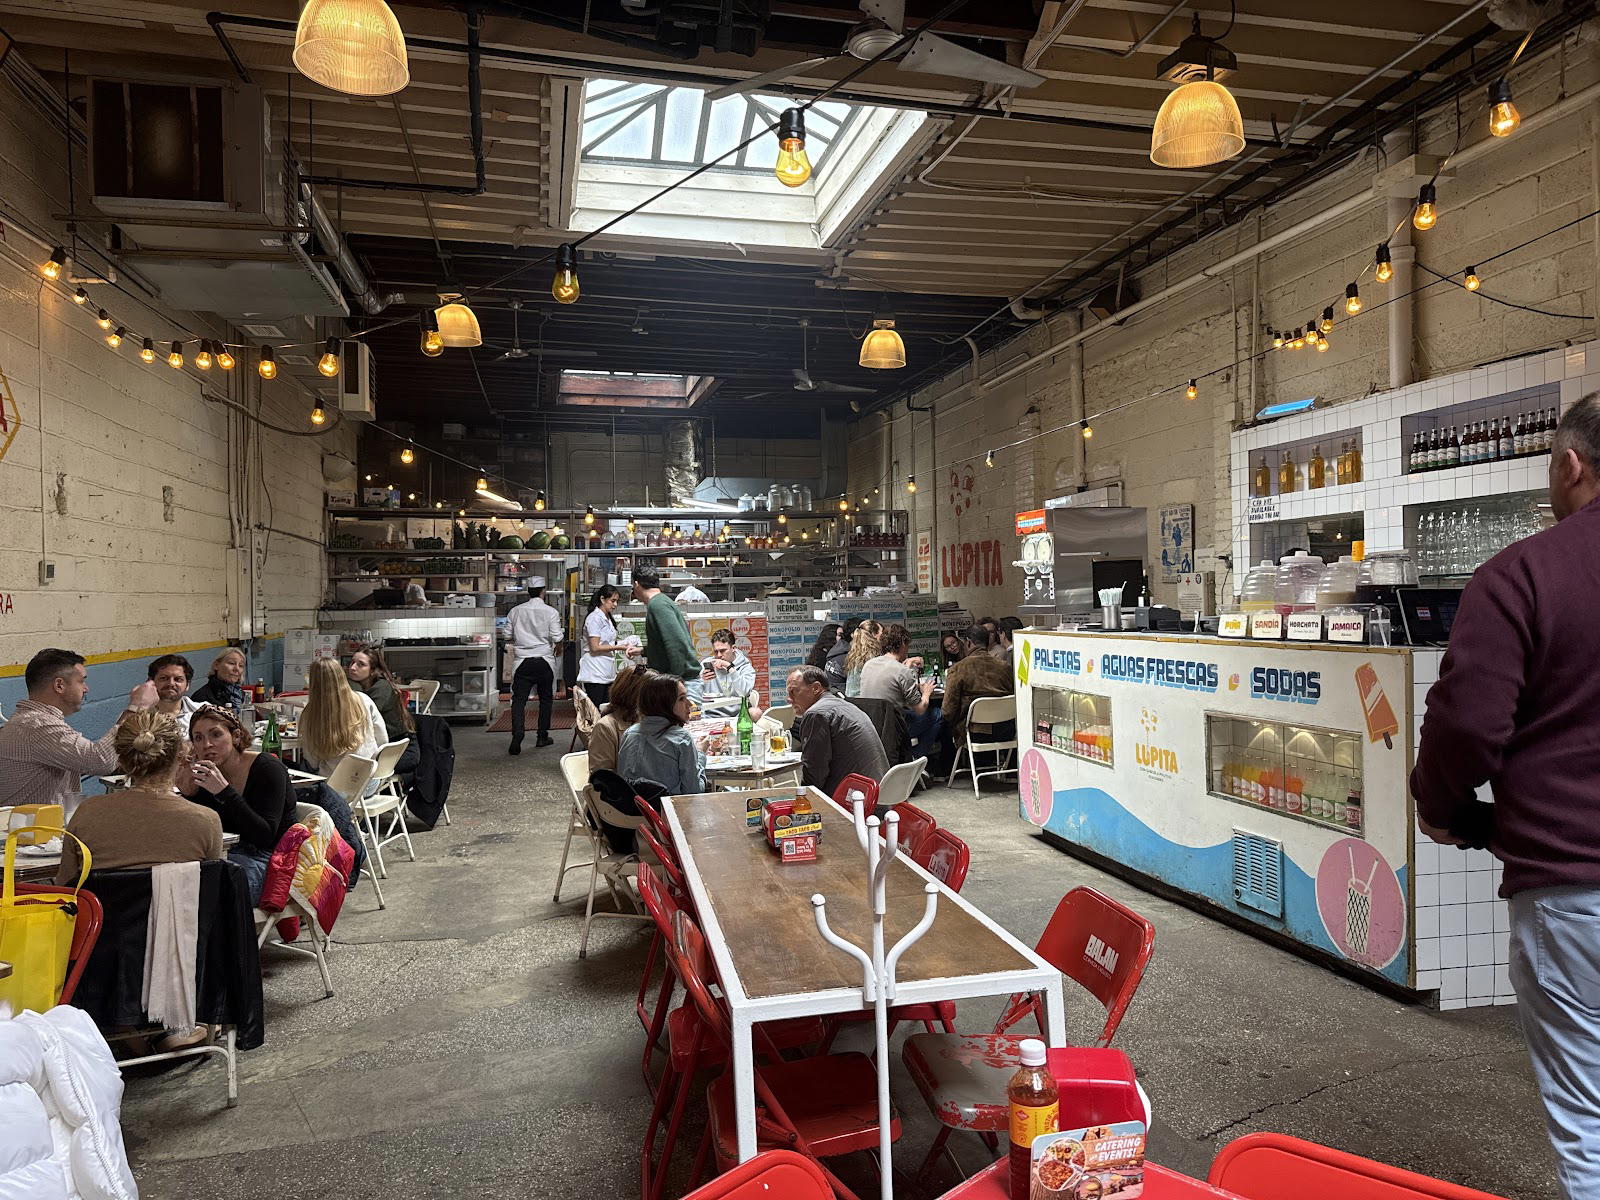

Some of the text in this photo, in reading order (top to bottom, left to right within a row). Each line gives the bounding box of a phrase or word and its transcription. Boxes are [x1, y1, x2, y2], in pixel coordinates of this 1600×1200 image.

[941, 539, 1004, 588] LUPITA
[776, 603, 808, 612] HERMOSA
[1254, 618, 1279, 629] SANDÍA
[1289, 620, 1319, 629] HORCHATA
[1330, 622, 1362, 631] JAMAICA
[770, 647, 802, 655] MONOPOLIO
[1034, 648, 1321, 704] PALETAS AGUAS FRESCAS SODAS
[1135, 742, 1179, 774] LUPITA
[1095, 1137, 1141, 1152] CATERING
[1099, 1148, 1137, 1161] EVENTS!
